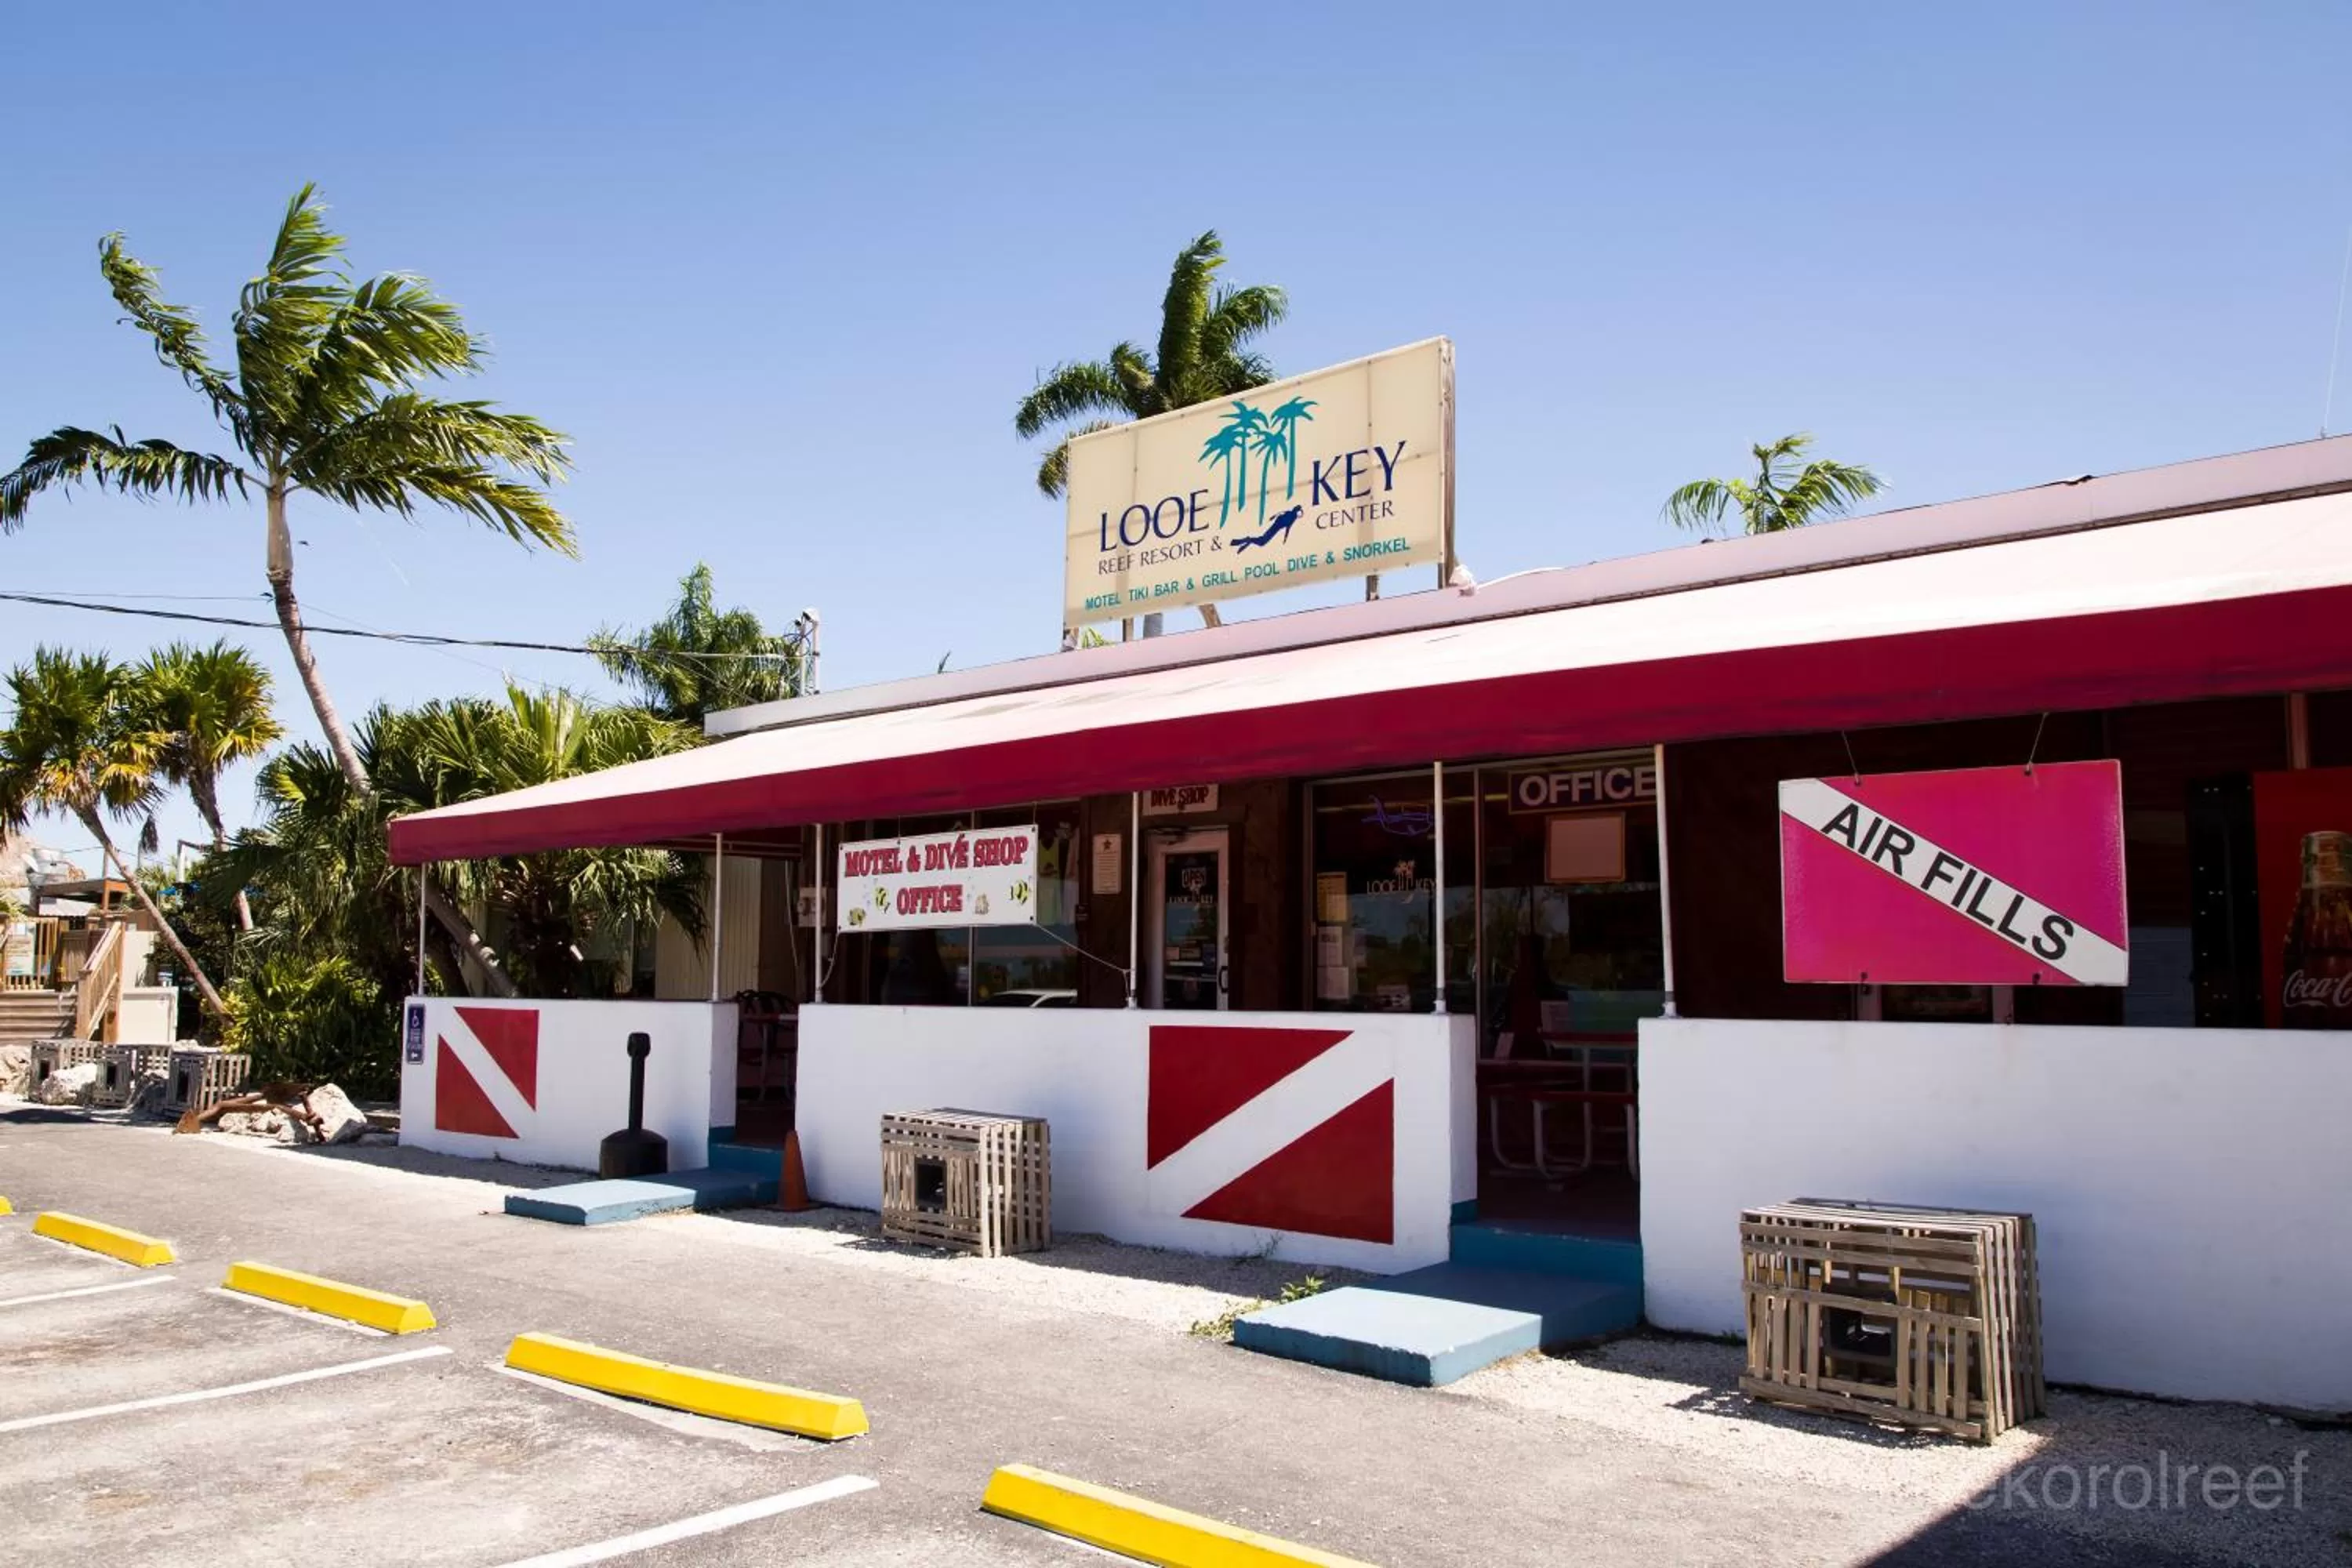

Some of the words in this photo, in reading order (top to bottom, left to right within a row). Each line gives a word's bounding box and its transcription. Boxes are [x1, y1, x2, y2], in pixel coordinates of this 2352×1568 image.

[1100, 489, 1210, 552] LOOE
[1312, 441, 1406, 506] KEY
[1098, 550, 1132, 575] REEF
[1141, 541, 1202, 570] RESORT
[1210, 536, 1223, 550] &
[1316, 500, 1393, 530] CENTER
[1086, 593, 1121, 610] MOTEL
[1129, 586, 1149, 602] TIKI
[1154, 581, 1179, 597] BAR
[1187, 579, 1194, 590] &
[1202, 570, 1239, 588] GRILL
[1244, 563, 1280, 579] POOL
[1288, 555, 1318, 572] DIVE
[1326, 551, 1335, 564] &
[1344, 538, 1410, 561] SNORKEL
[1519, 767, 1657, 807] OFFICE
[844, 848, 903, 877] MOTEL
[907, 846, 920, 873] &
[974, 836, 1029, 867] SHOP
[1821, 802, 1916, 876] AIR
[1920, 851, 2074, 961] FILLS
[897, 884, 963, 916] OFFICE
